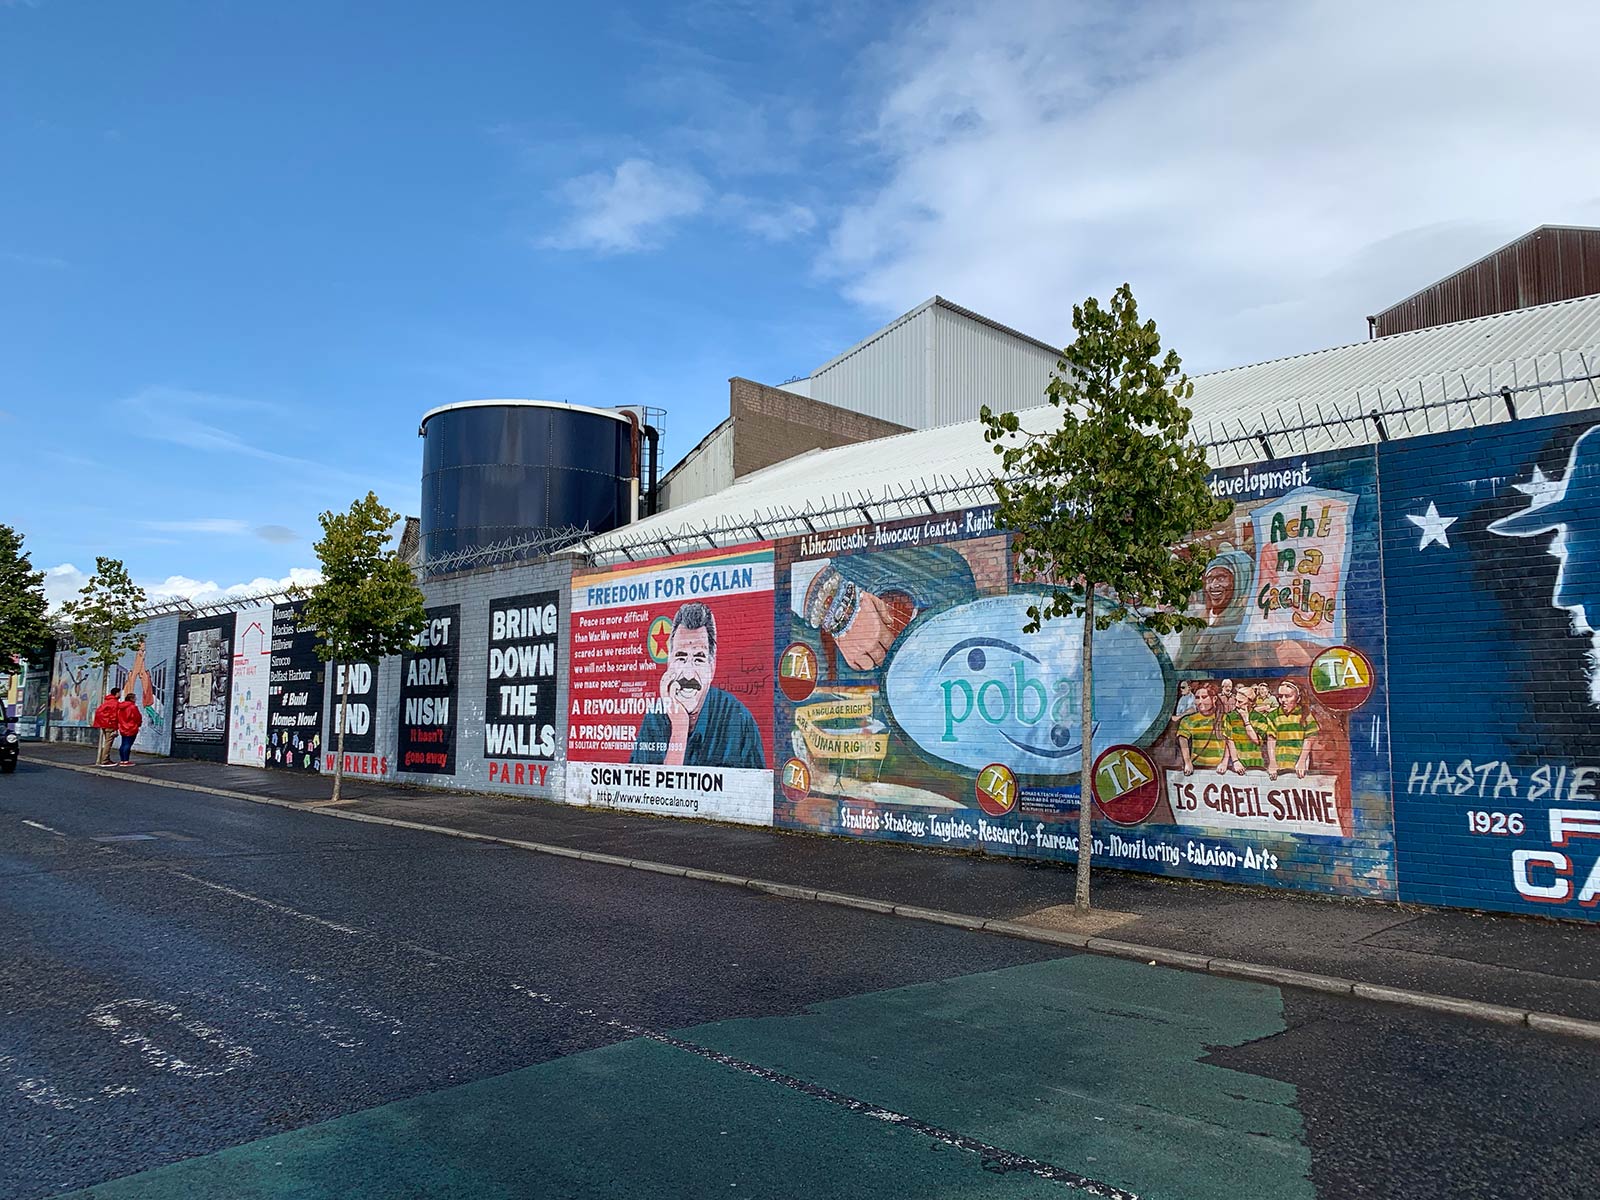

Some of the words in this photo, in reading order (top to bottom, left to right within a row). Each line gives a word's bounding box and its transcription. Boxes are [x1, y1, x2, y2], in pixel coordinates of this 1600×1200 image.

[1209, 461, 1312, 496] development
[1270, 505, 1332, 543] Acht
[1276, 548, 1324, 575] na
[587, 582, 649, 606] FREEDOM
[655, 576, 685, 599] FOR
[1258, 579, 1336, 627] Gaeilge
[492, 603, 557, 641] BRING
[579, 617, 598, 627] Peace
[605, 616, 622, 625] more
[623, 610, 649, 623] difficult
[575, 632, 588, 643] than
[611, 632, 628, 640] were
[628, 628, 639, 638] not
[489, 643, 554, 679] DOWN
[574, 647, 595, 658] scared
[596, 649, 603, 657] as
[604, 648, 614, 656] we
[336, 663, 372, 695] END
[406, 657, 448, 686] ARIA
[574, 666, 583, 674] we
[584, 662, 595, 673] will
[595, 662, 606, 673] not
[606, 661, 615, 672] be
[615, 660, 638, 671] scared
[639, 659, 657, 670] when
[573, 681, 583, 689] we
[584, 680, 599, 689] make
[405, 697, 449, 725] NISM
[500, 684, 538, 716] THE
[571, 699, 580, 715] A
[583, 697, 681, 715] REVOLUTIONARY
[807, 705, 845, 718] LANGUAGE
[271, 712, 296, 726] Homes
[485, 723, 555, 757] WALLS
[569, 725, 577, 739] A
[579, 724, 637, 741] PRISONER
[404, 751, 424, 766] gone
[574, 741, 599, 750] SOLITARY
[600, 741, 638, 751] CONFINEMENT
[639, 742, 656, 751] SINCE
[656, 742, 667, 752] FEB
[326, 754, 388, 774] WRKERS
[489, 762, 548, 786] PARTY
[590, 768, 621, 786] SIGN
[625, 769, 650, 787] THE
[655, 771, 724, 792] PETITION
[1407, 759, 1518, 798] HASTA
[1173, 783, 1197, 811] IS
[1203, 783, 1269, 818] GAEIL
[1267, 789, 1337, 824] SINNE
[1467, 810, 1525, 836] 1926
